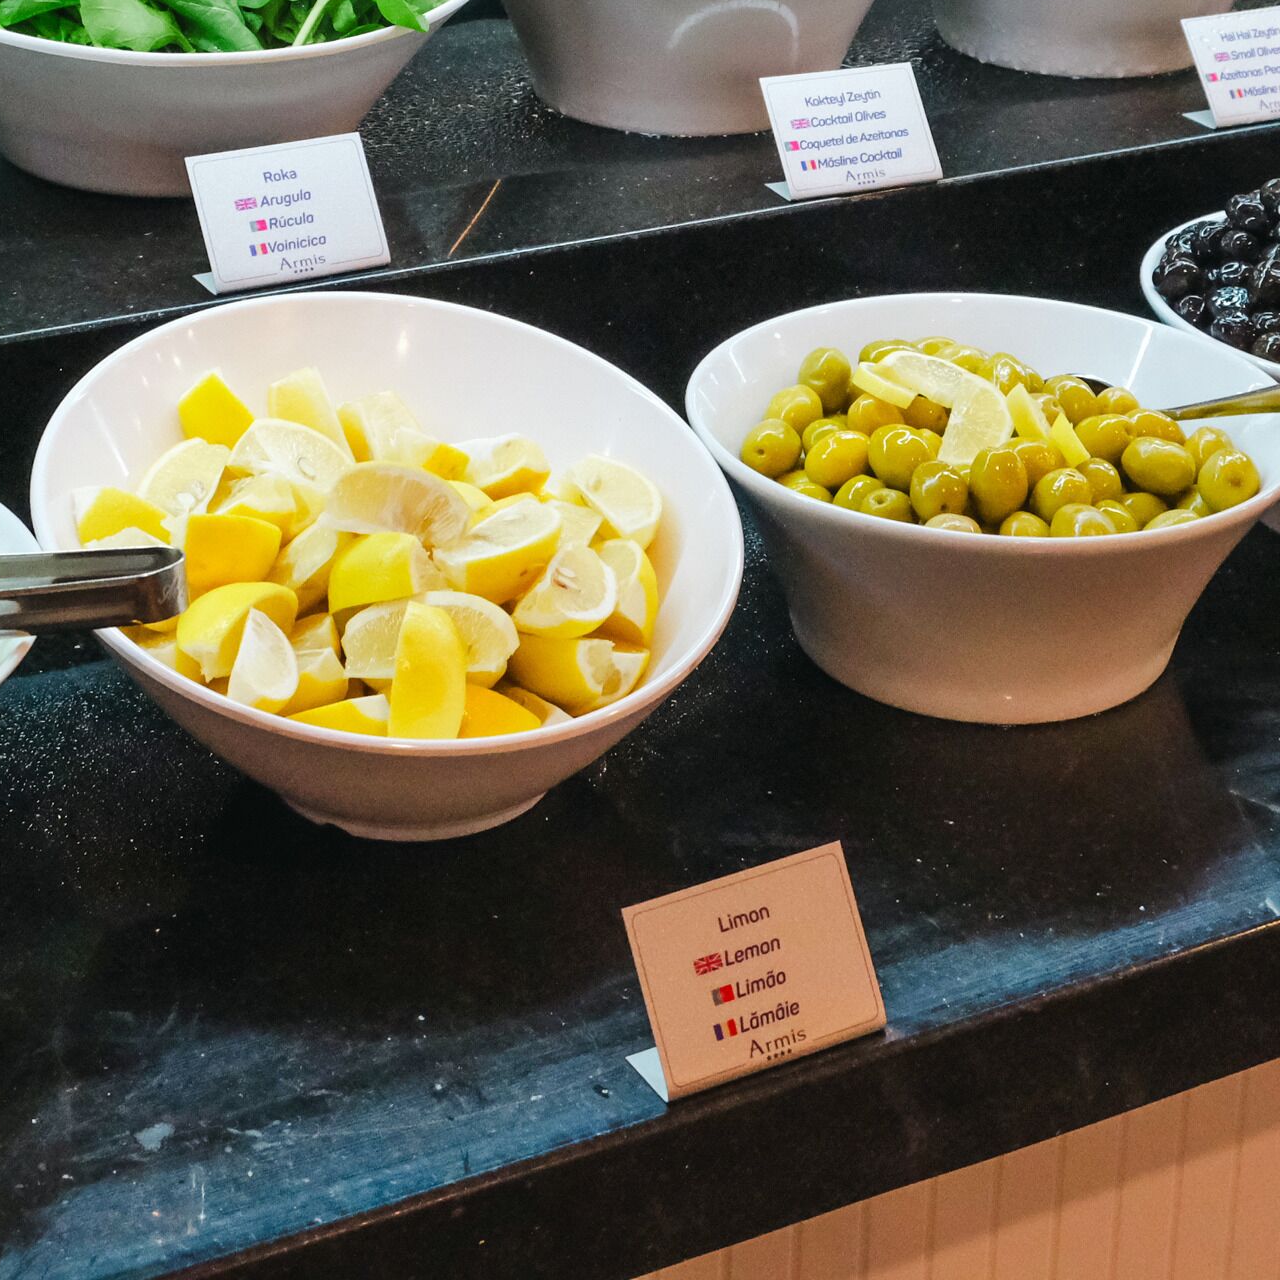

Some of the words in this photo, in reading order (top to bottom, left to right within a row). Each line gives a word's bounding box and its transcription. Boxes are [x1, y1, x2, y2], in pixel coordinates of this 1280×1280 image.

[1220, 31, 1236, 42] Hal
[1236, 29, 1251, 40] Hal
[1252, 26, 1280, 40] Zeytin
[1230, 48, 1256, 61] Small
[1219, 66, 1263, 81] Azeitonas
[804, 91, 846, 108] Kokteyl
[847, 88, 881, 103] Zeytin
[810, 112, 854, 128] Cocktail
[855, 109, 887, 122] Olives
[799, 136, 844, 152] Coquetel
[845, 133, 858, 145] de
[859, 127, 909, 142] Azeitonas
[817, 153, 858, 169] Măsline
[859, 148, 903, 164] Cocktail
[263, 169, 298, 184] Roka
[845, 168, 886, 183] Armis
[260, 189, 312, 208] Arugula
[269, 212, 314, 230] Rúcula
[280, 254, 327, 271] Armis
[718, 906, 771, 933] Limon
[724, 937, 781, 966] Lemon
[736, 969, 787, 999] Limão
[739, 1000, 800, 1033] Lămâie
[749, 1028, 808, 1058] Armis
